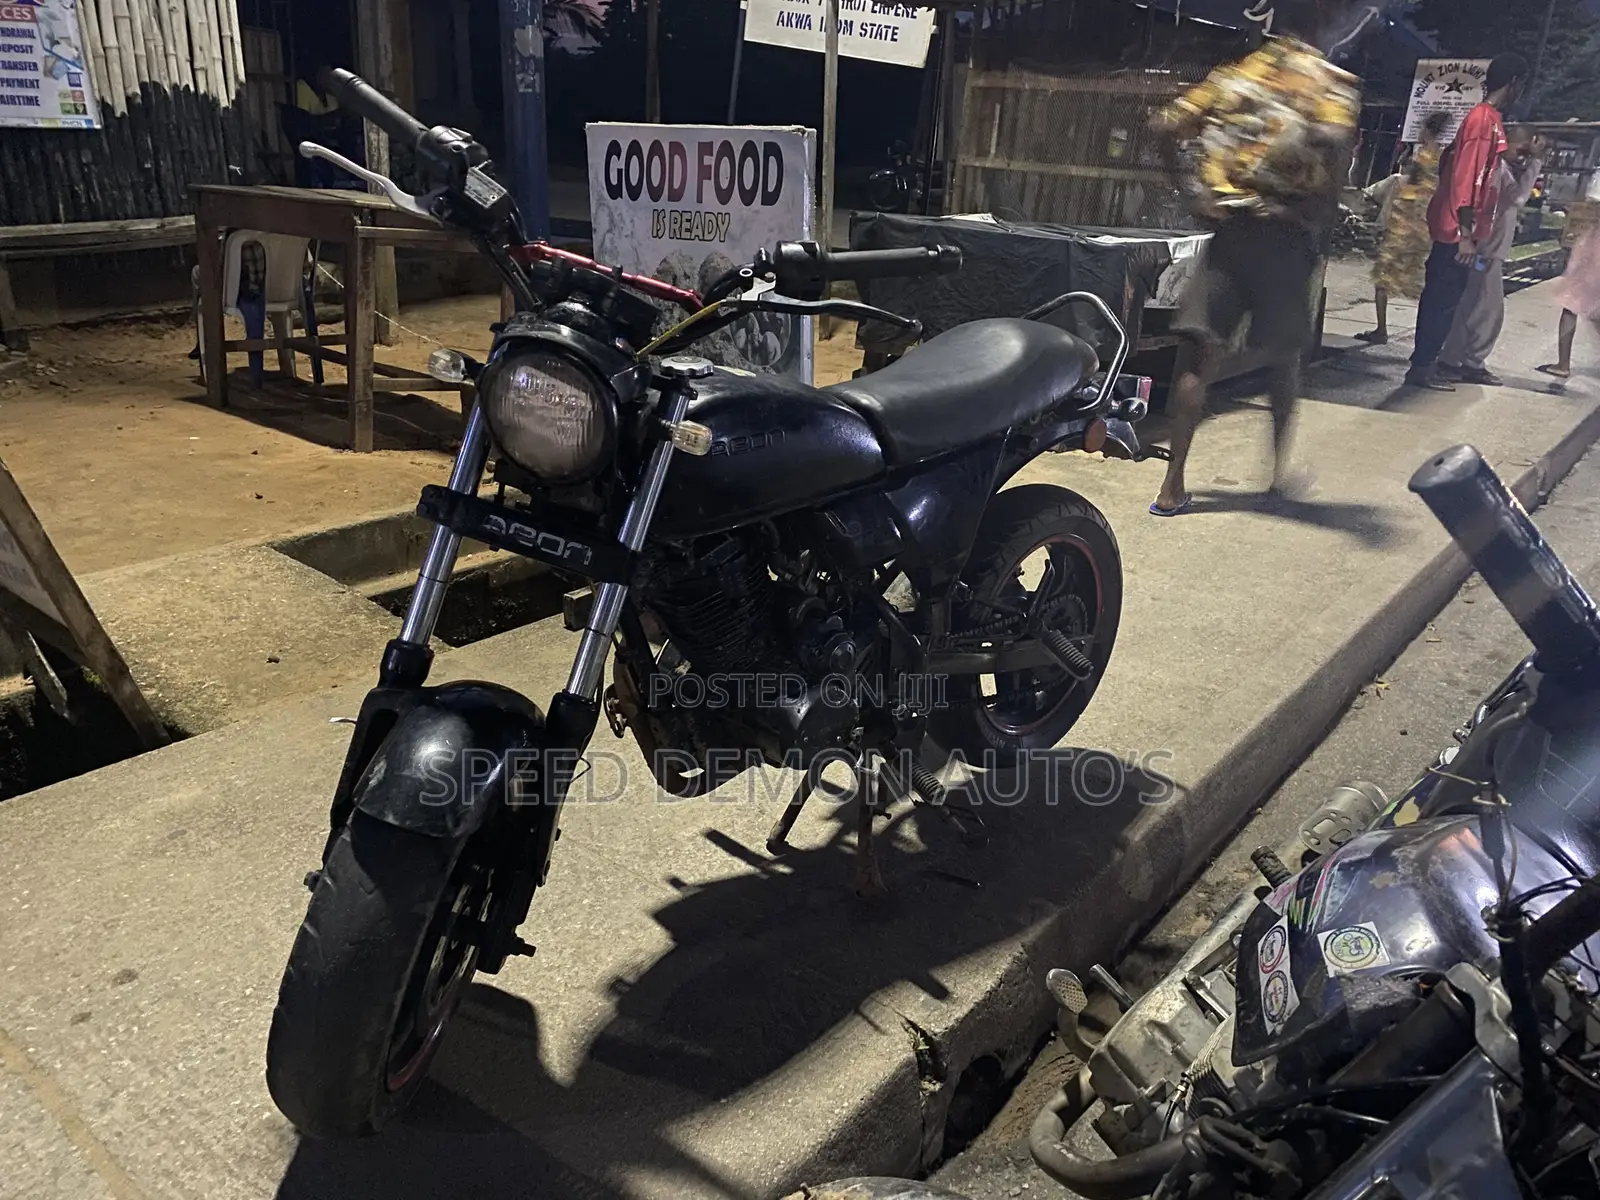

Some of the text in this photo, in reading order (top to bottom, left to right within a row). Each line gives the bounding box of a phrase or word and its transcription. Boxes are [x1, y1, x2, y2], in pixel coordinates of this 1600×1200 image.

[0, 6, 31, 20] CES
[776, 10, 899, 42] AKWA IOM STATE
[0, 43, 33, 54] EPOSIT
[1414, 62, 1486, 98] MOUNT ZION LIGHT
[0, 94, 41, 107] AIRTIME
[604, 139, 784, 206] GOOD FOOD
[652, 208, 731, 242] IS READY
